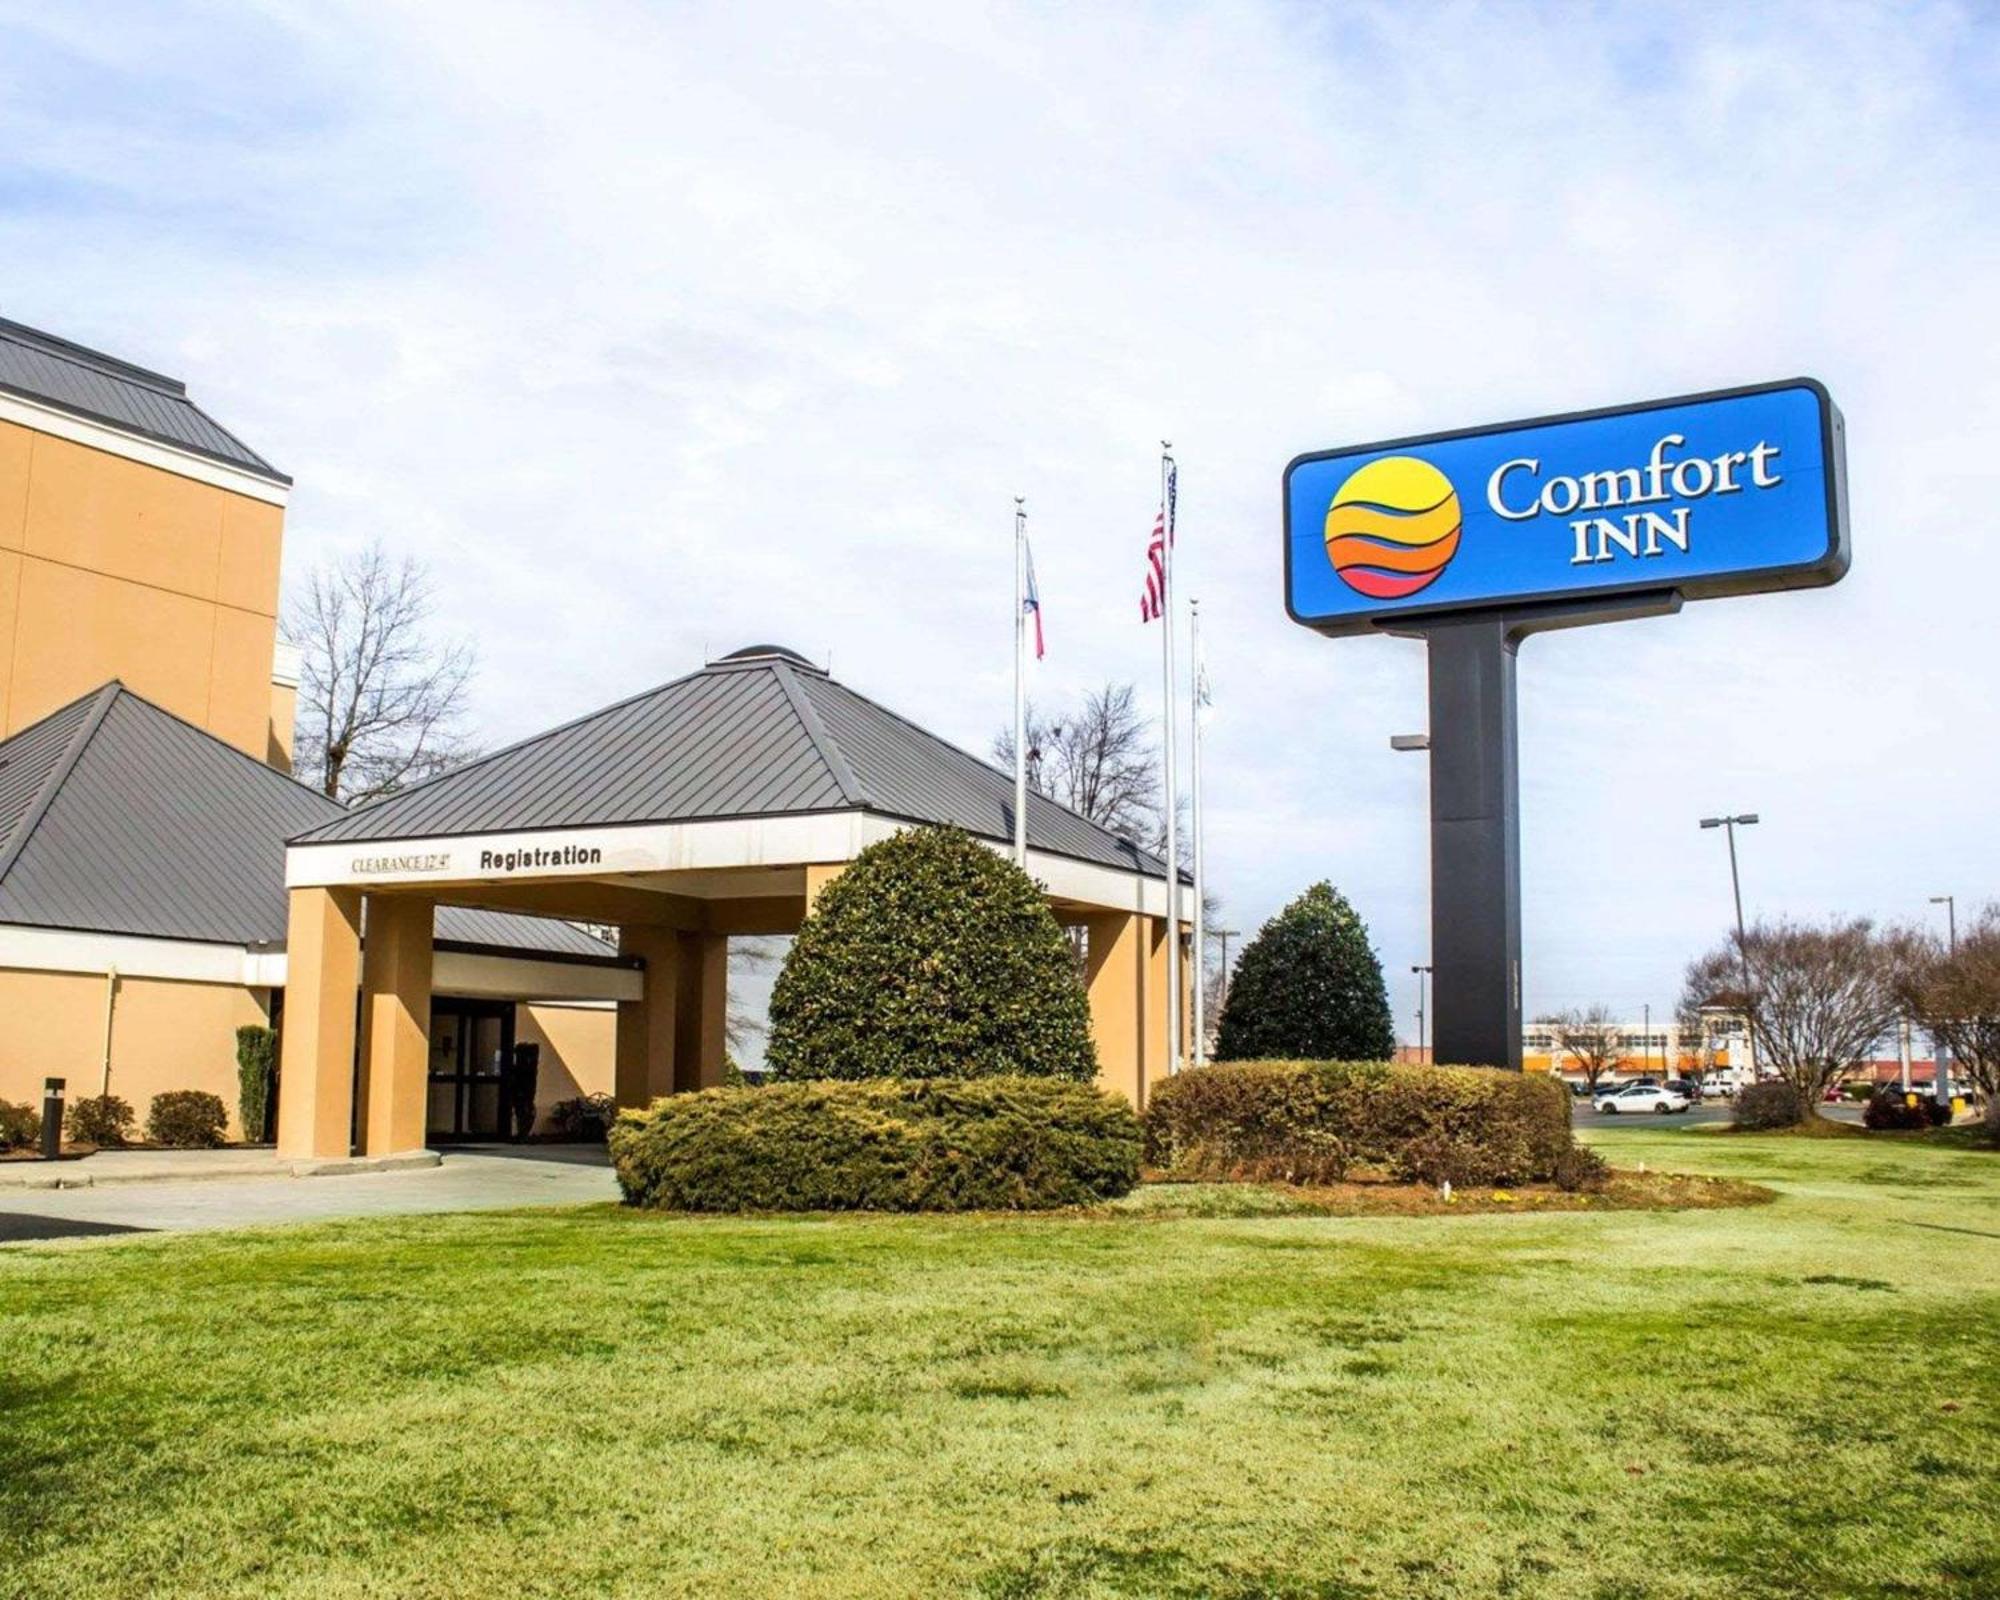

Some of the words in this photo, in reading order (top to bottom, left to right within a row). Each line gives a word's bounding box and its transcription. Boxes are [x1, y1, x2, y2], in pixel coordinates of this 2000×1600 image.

[1487, 434, 1781, 519] Comfort
[1570, 509, 1690, 564] INN
[352, 857, 421, 873] CLEARANCE
[480, 845, 601, 871] Registration
